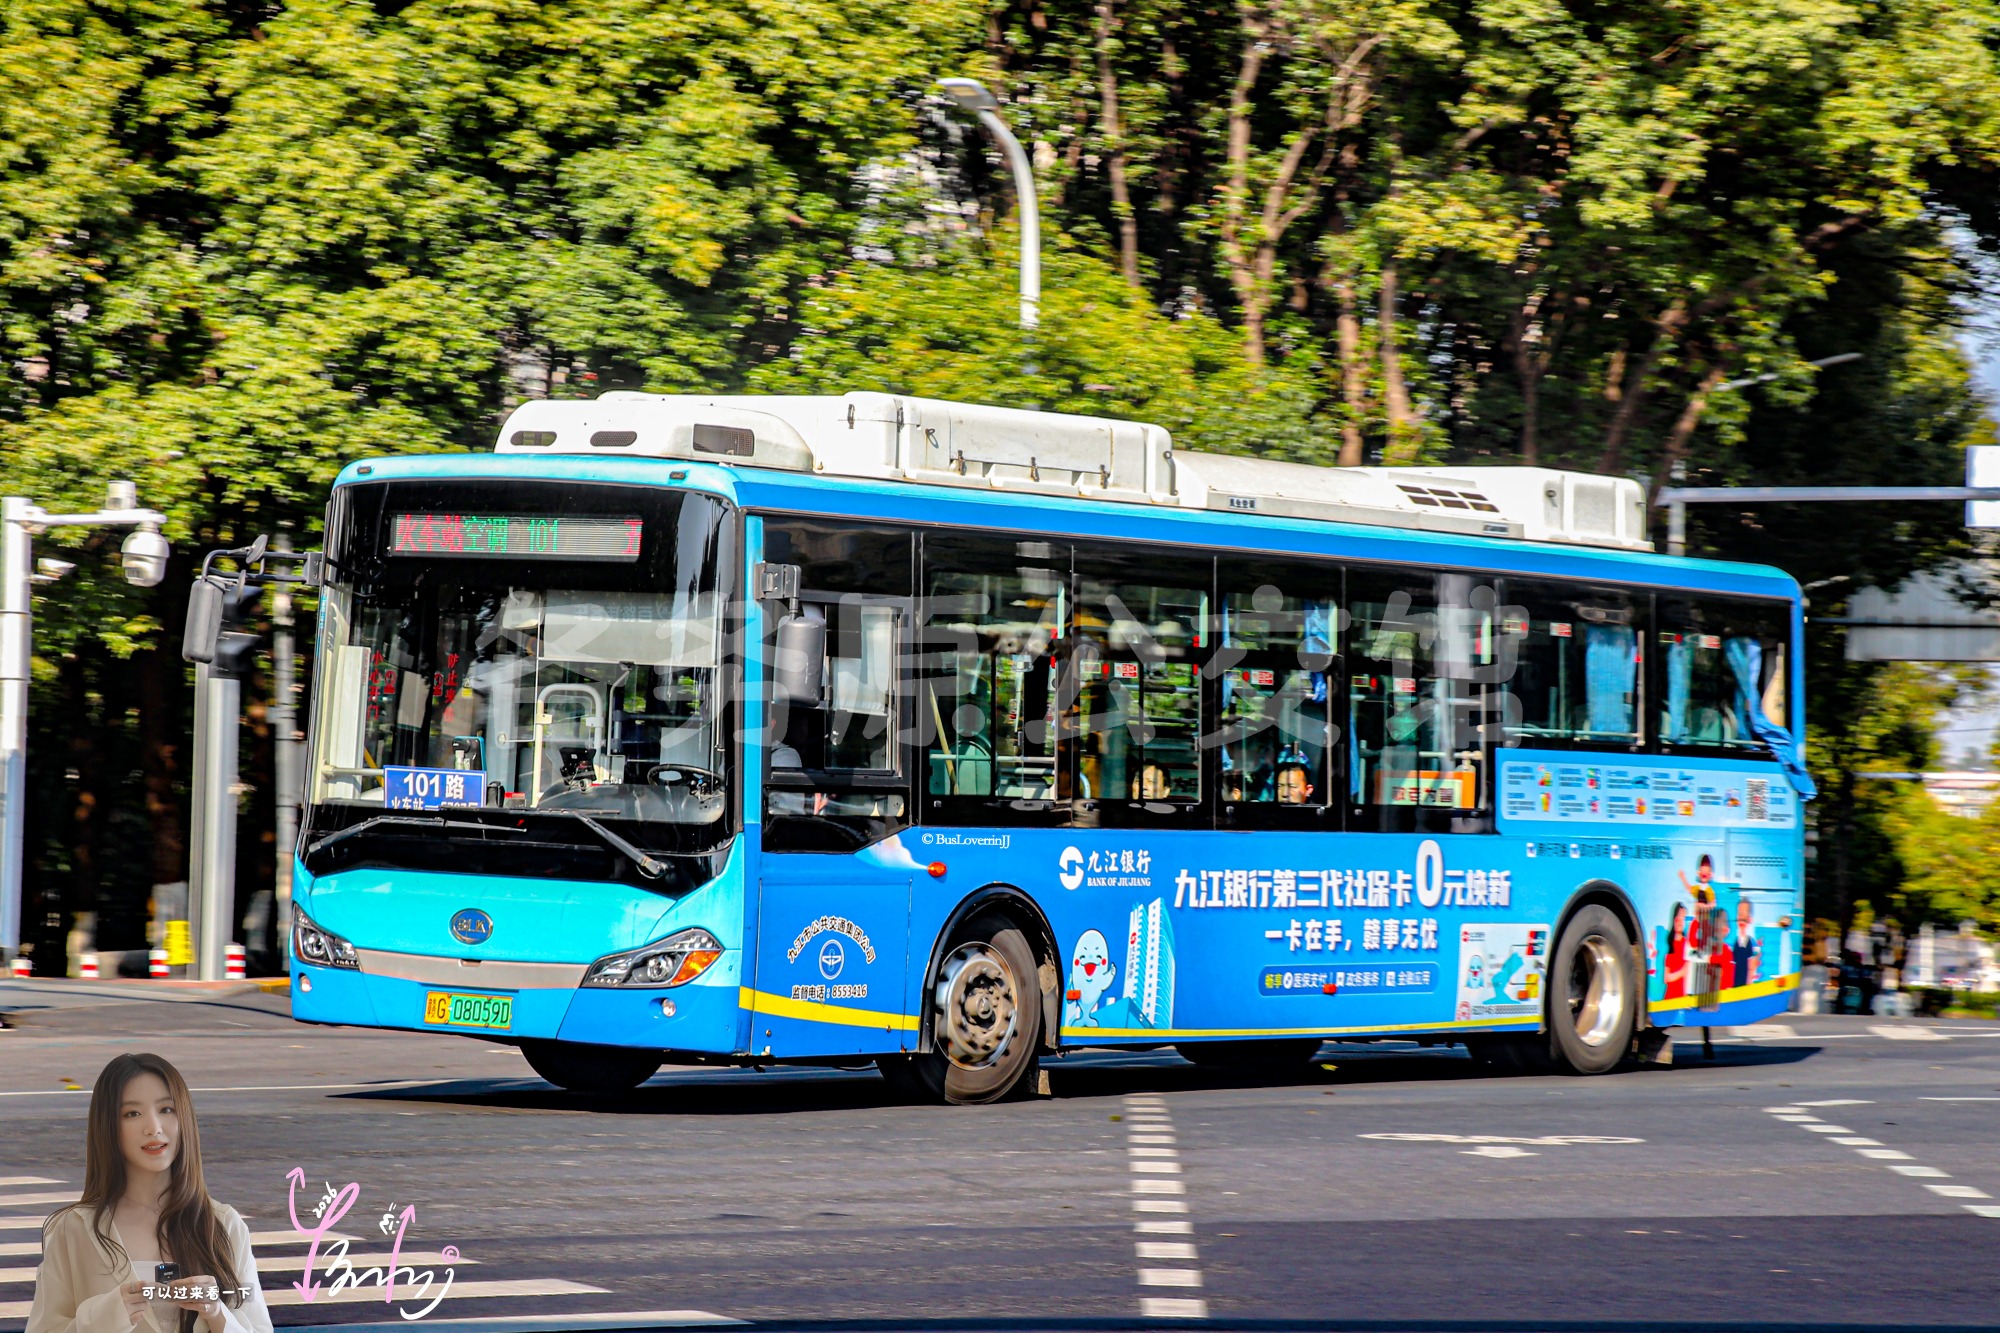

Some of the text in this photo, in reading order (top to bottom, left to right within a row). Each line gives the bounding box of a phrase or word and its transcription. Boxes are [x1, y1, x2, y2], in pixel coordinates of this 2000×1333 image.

[526, 518, 559, 552] 101
[1087, 849, 1151, 874] 九江银行
[1174, 839, 1512, 909] 九江银行第三代社保卡0元焕新
[1087, 877, 1151, 887] BANK OF JIUJIANG
[787, 915, 876, 964] 九江市公共交通集团公司
